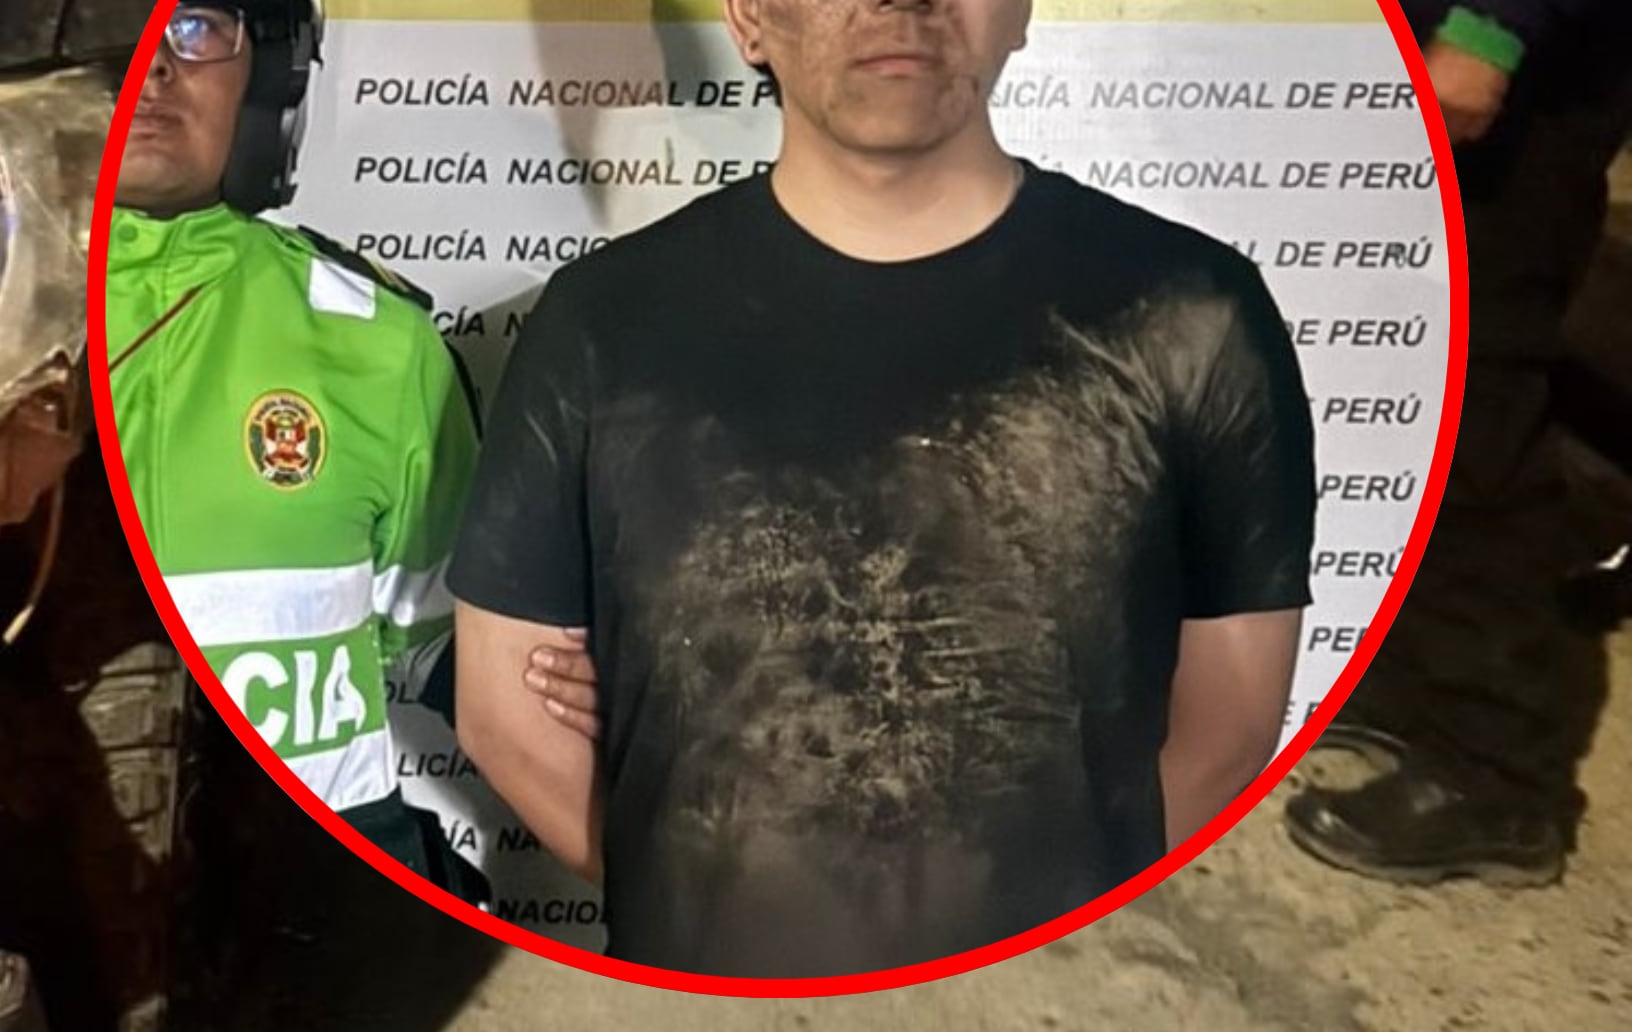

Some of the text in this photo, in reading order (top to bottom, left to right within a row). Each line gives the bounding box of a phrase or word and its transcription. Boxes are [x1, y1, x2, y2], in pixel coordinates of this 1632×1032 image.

[355, 74, 489, 106] POLICÍA
[508, 80, 686, 107] NACIONAL
[695, 80, 744, 107] DE
[1090, 81, 1274, 109] NACIONAL
[1285, 82, 1336, 109] DE
[354, 153, 488, 185] POLICÍA
[507, 159, 683, 186] NACIONAL
[693, 160, 741, 186] DE
[1088, 161, 1268, 189] NACIONAL
[1280, 162, 1328, 189] DE
[1339, 155, 1436, 190] PERÚ
[355, 230, 487, 261] POLICÍA
[1275, 241, 1326, 268] DE
[1334, 236, 1433, 269] PERÚ
[1328, 315, 1427, 348] PERÚ
[1322, 393, 1422, 425] PERÚ
[1318, 471, 1417, 501] PERÚ
